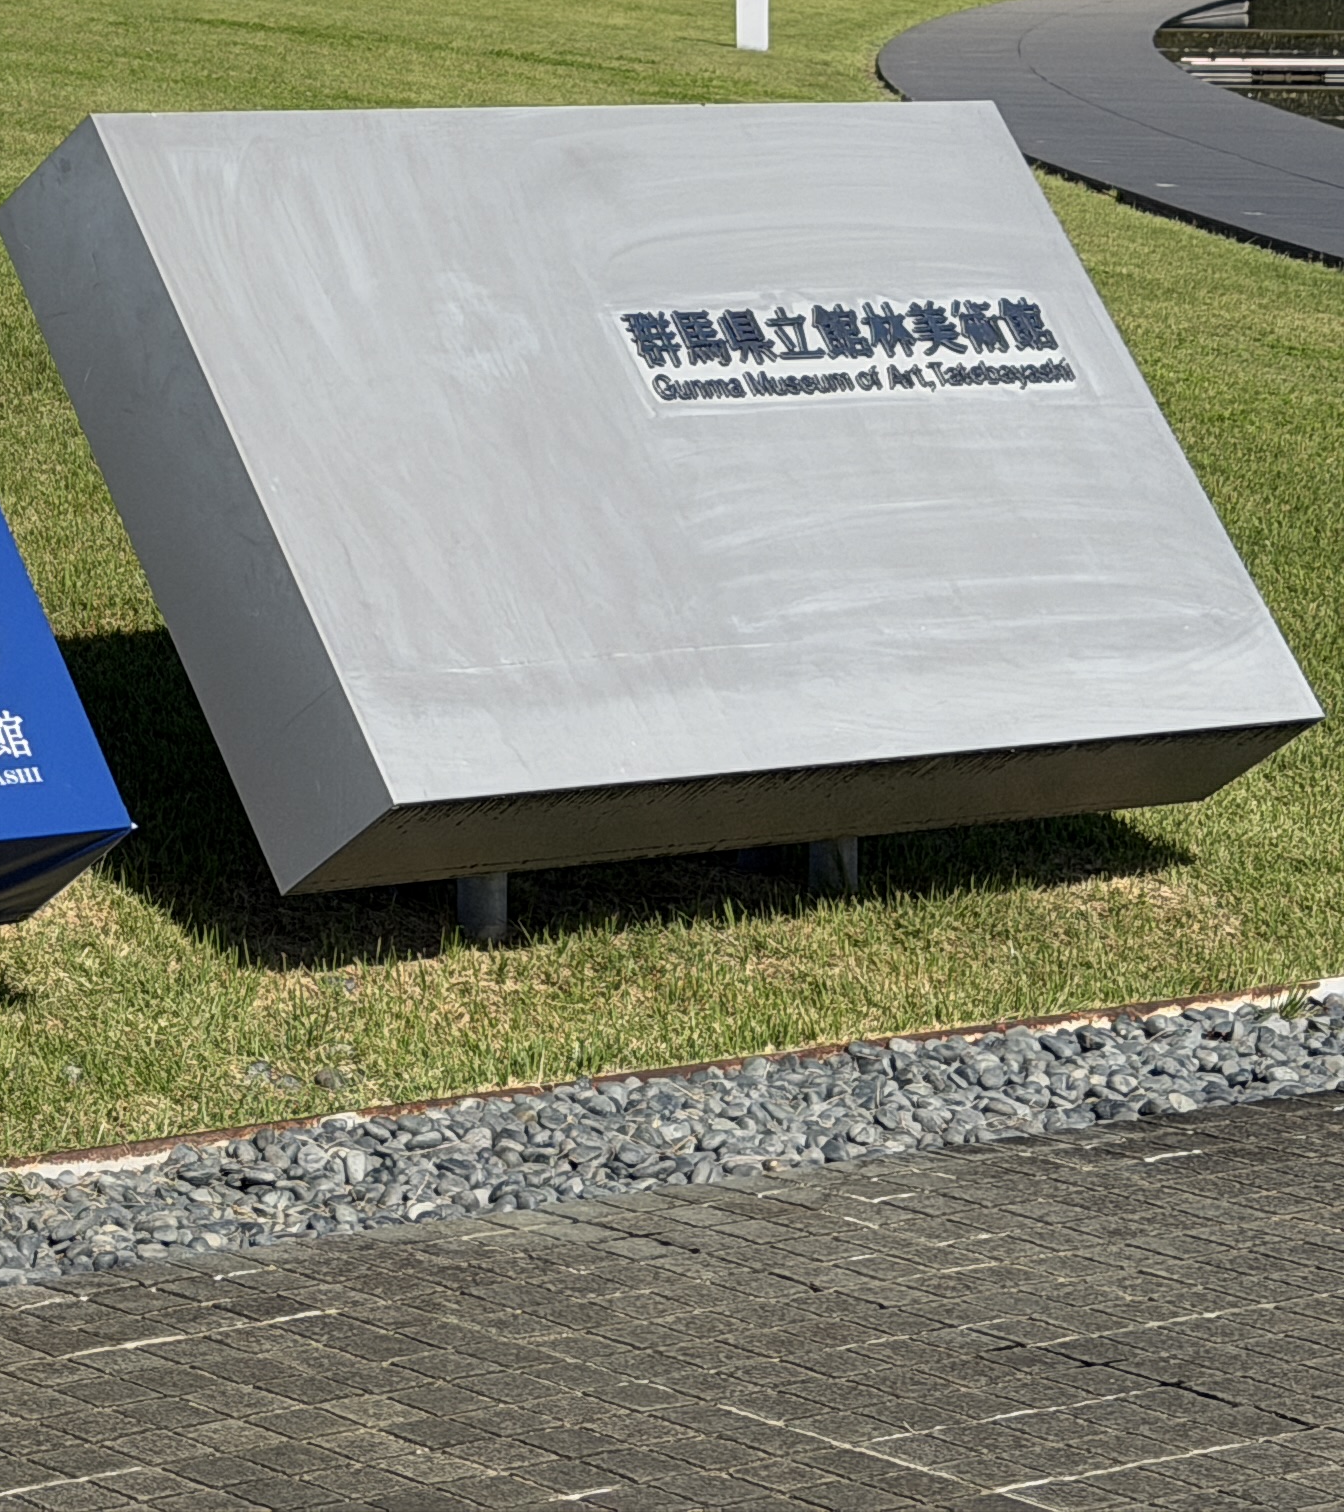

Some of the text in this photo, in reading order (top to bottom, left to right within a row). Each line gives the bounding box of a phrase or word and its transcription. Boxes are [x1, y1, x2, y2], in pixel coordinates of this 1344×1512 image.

[622, 297, 1059, 368] 群馬県立館林美術館
[651, 374, 746, 402] Gunma
[742, 372, 855, 396] Museum
[854, 366, 883, 390] of
